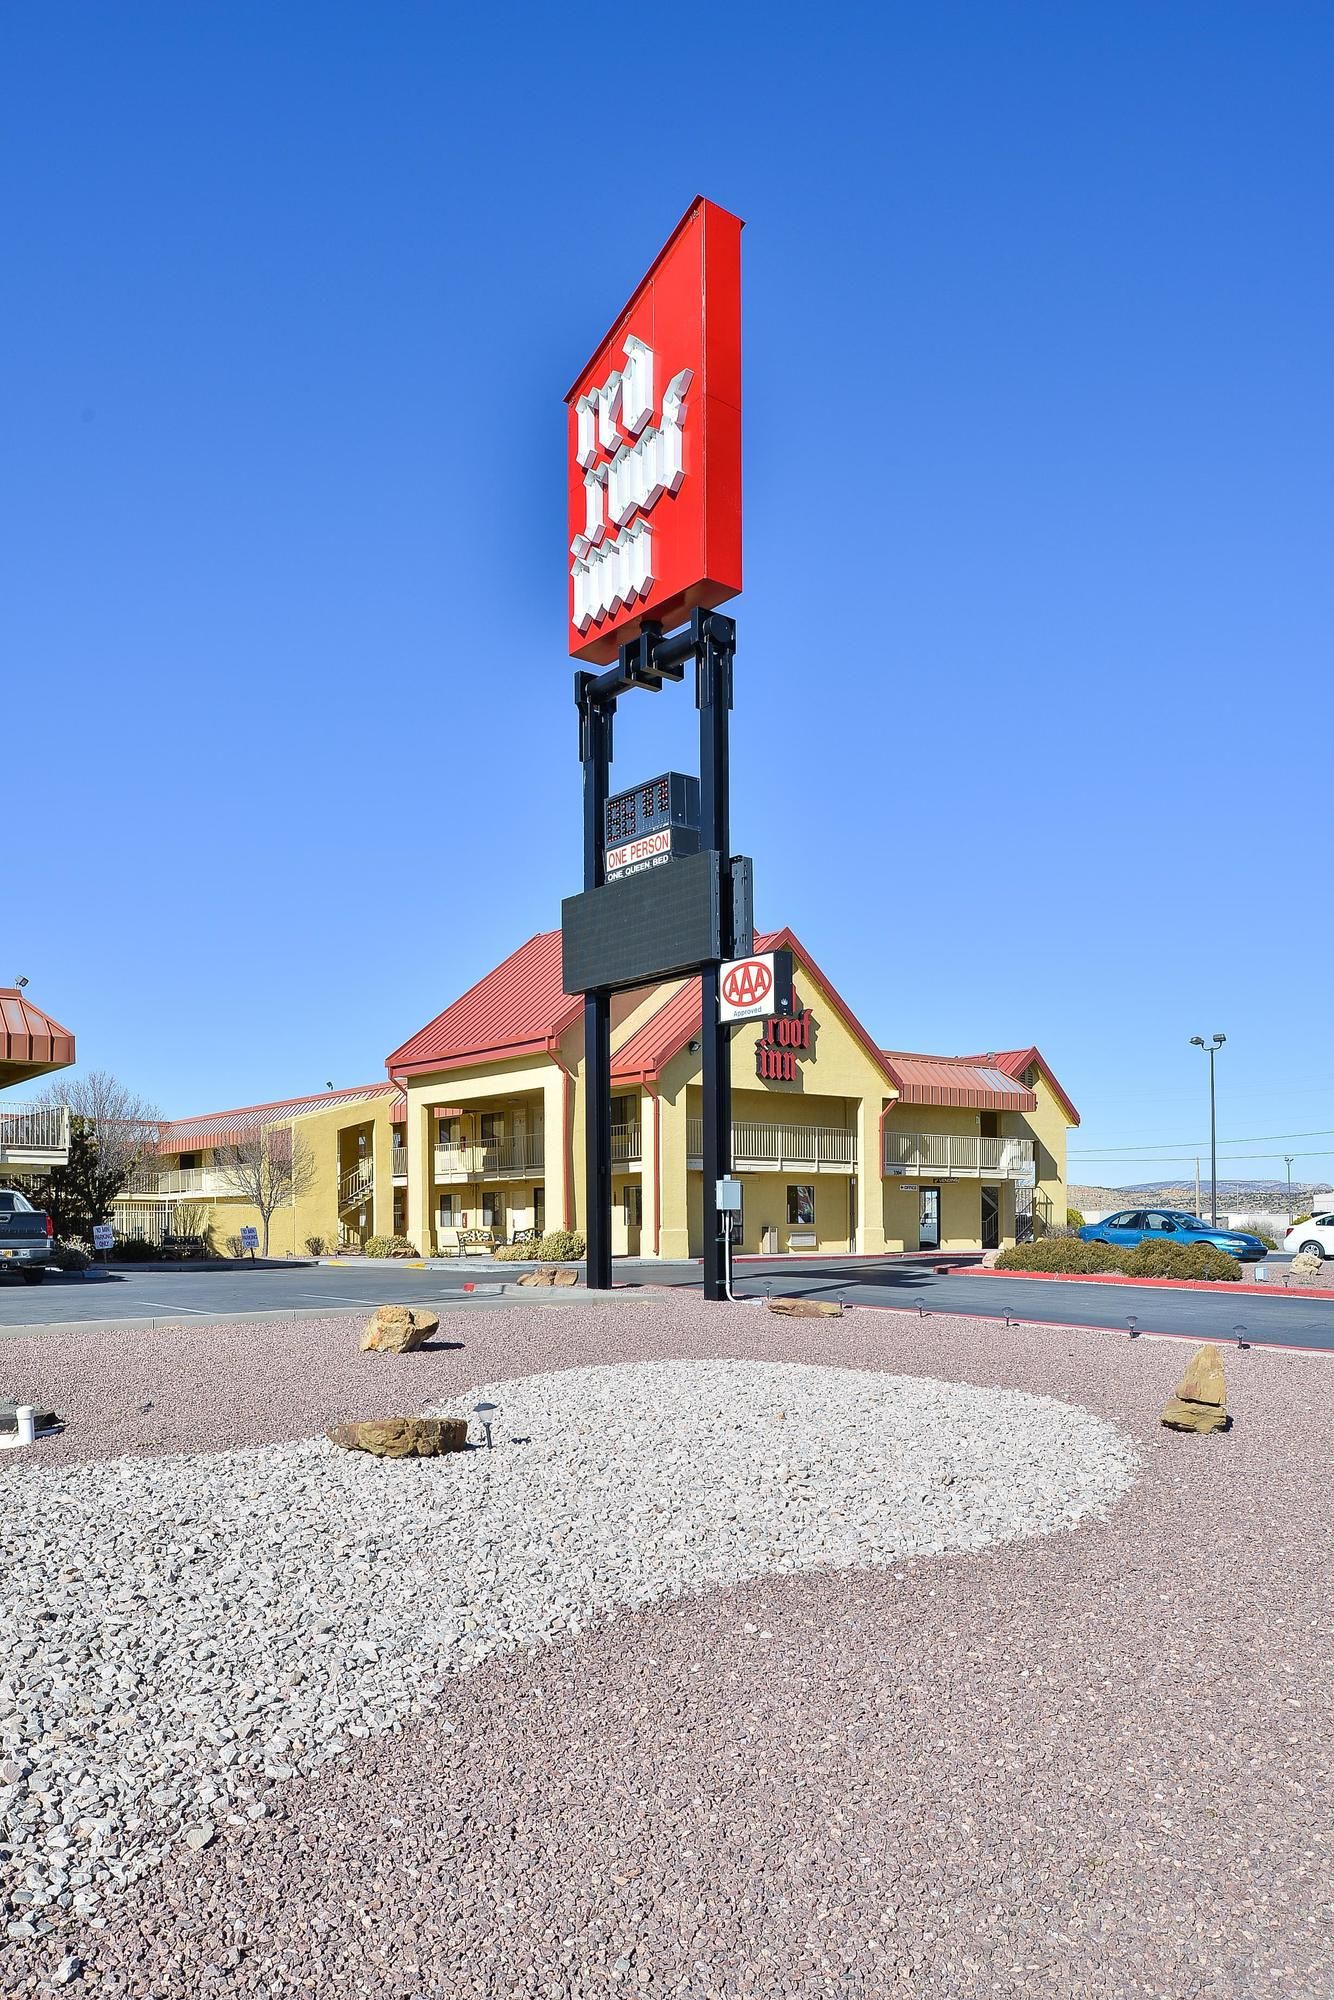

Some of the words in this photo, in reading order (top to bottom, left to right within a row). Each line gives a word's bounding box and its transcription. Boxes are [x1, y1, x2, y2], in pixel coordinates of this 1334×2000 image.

[575, 334, 654, 468] red
[583, 368, 695, 545] roof
[570, 518, 655, 632] inn
[607, 872, 624, 881] ONE
[625, 861, 650, 876] QUEEN
[652, 854, 669, 865] BED
[608, 848, 627, 868] ONE
[631, 833, 669, 860] PERSON
[728, 964, 768, 1004] AAA
[733, 1006, 762, 1017] Approved
[766, 1009, 814, 1049] roof
[759, 1040, 797, 1081] inn
